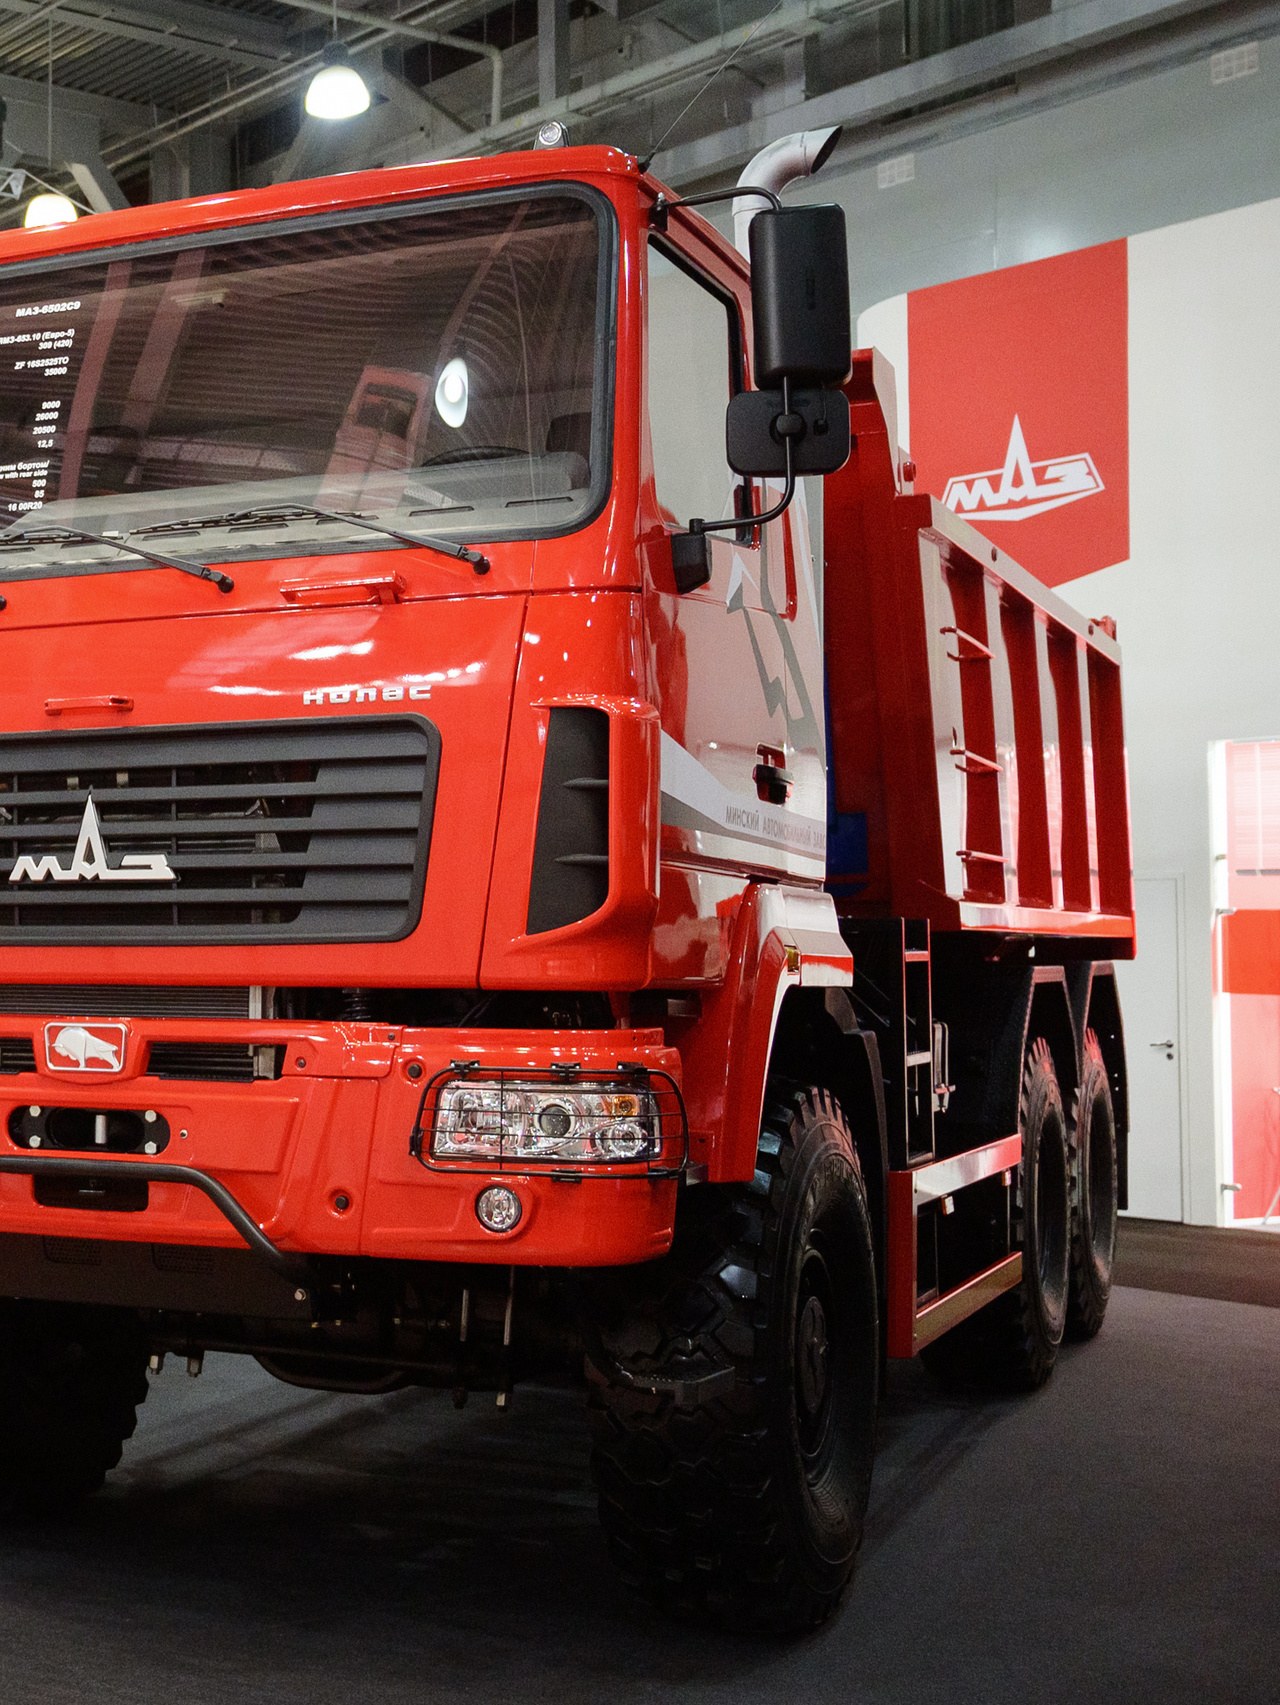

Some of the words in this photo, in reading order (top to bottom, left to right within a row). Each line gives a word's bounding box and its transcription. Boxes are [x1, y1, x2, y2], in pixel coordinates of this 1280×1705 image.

[42, 329, 75, 339] (Евро-5)
[53, 339, 73, 347] (420)
[44, 367, 67, 375] 35000
[35, 412, 58, 420] 26000
[33, 426, 56, 434] 20500
[946, 412, 1098, 512] МАЗ
[32, 479, 46, 487] 500
[34, 490, 44, 498] 85
[725, 805, 760, 831] МИНСКИЙ
[8, 794, 177, 881] МАЗ
